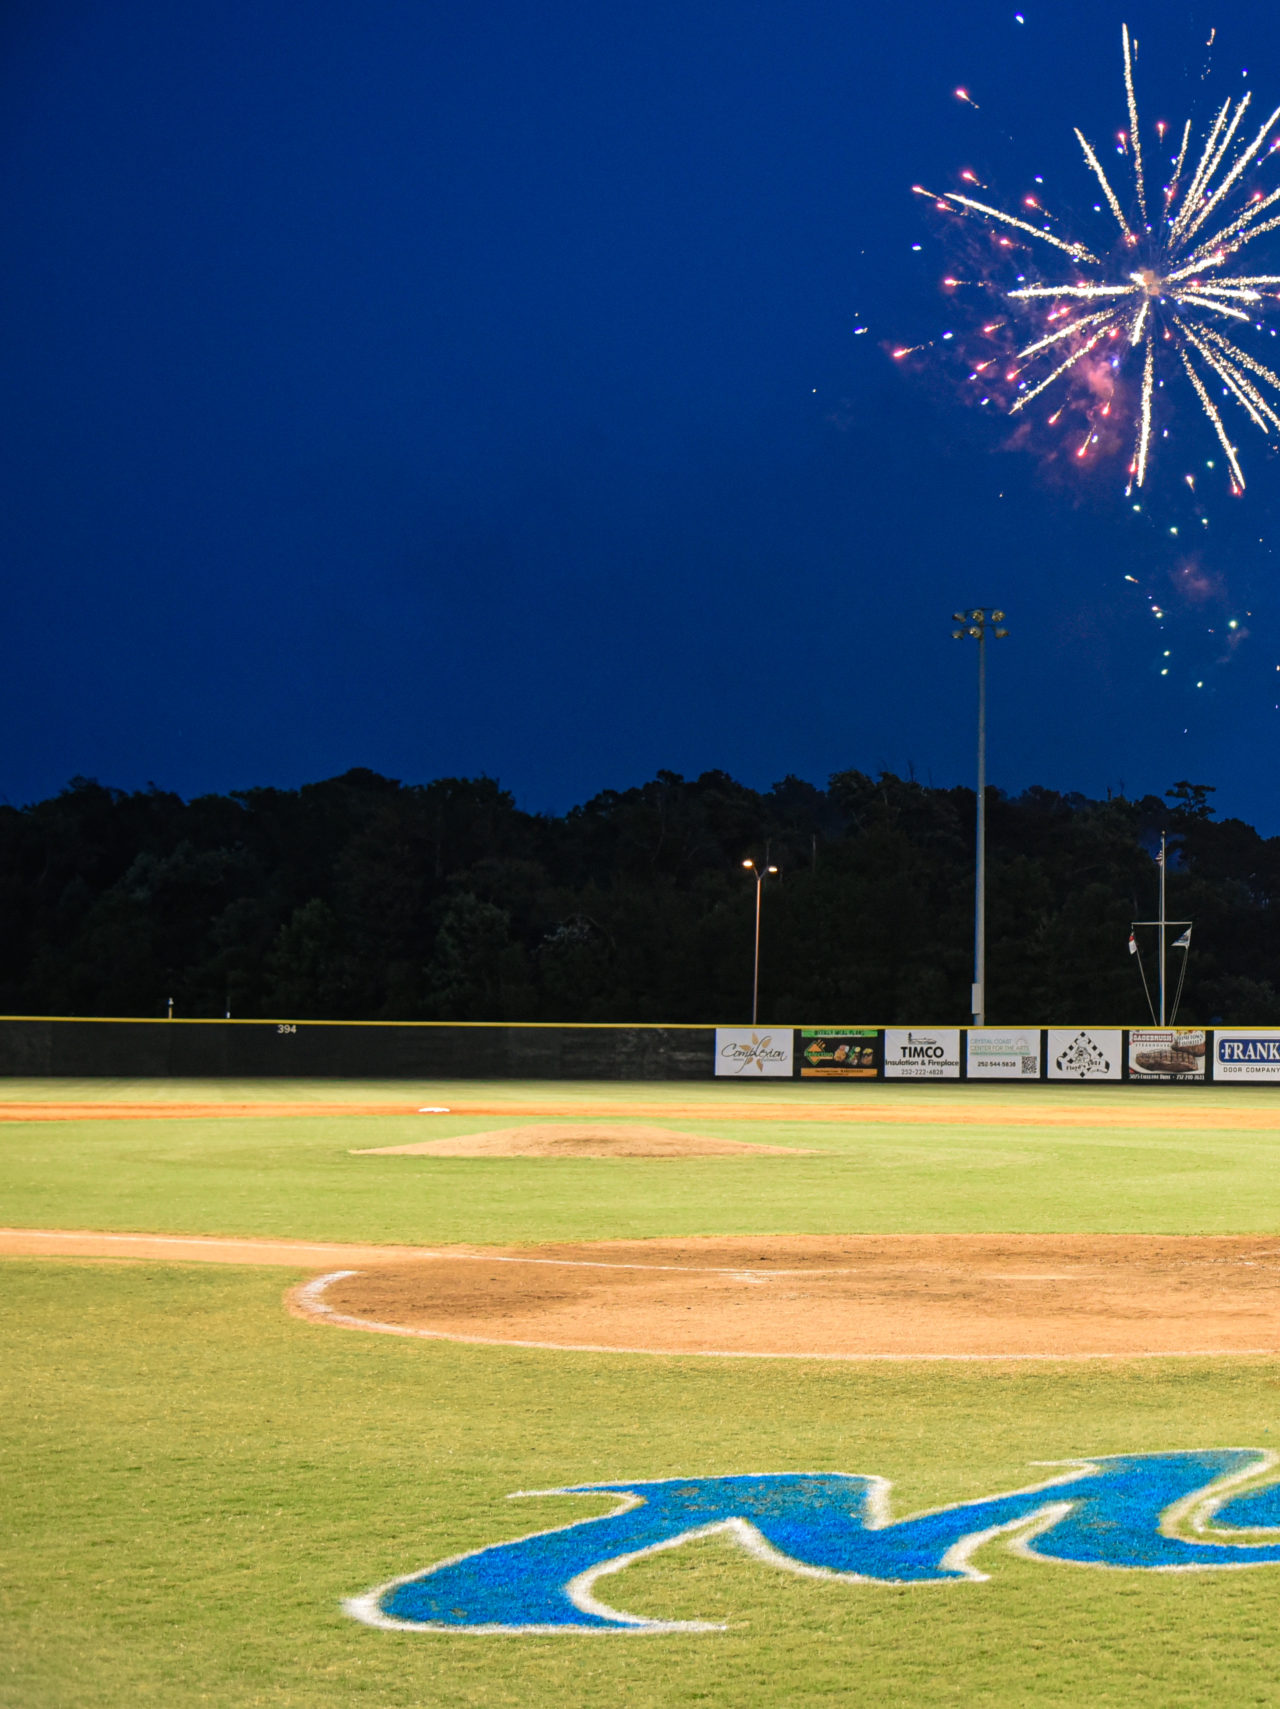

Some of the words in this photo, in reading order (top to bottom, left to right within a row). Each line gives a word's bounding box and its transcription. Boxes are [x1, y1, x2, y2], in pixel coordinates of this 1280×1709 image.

[277, 1024, 297, 1034] 394
[721, 1035, 788, 1074] Complexion
[900, 1046, 944, 1059] TIMCO
[1224, 1043, 1280, 1060] FRANK
[928, 1059, 959, 1068] Fireplace
